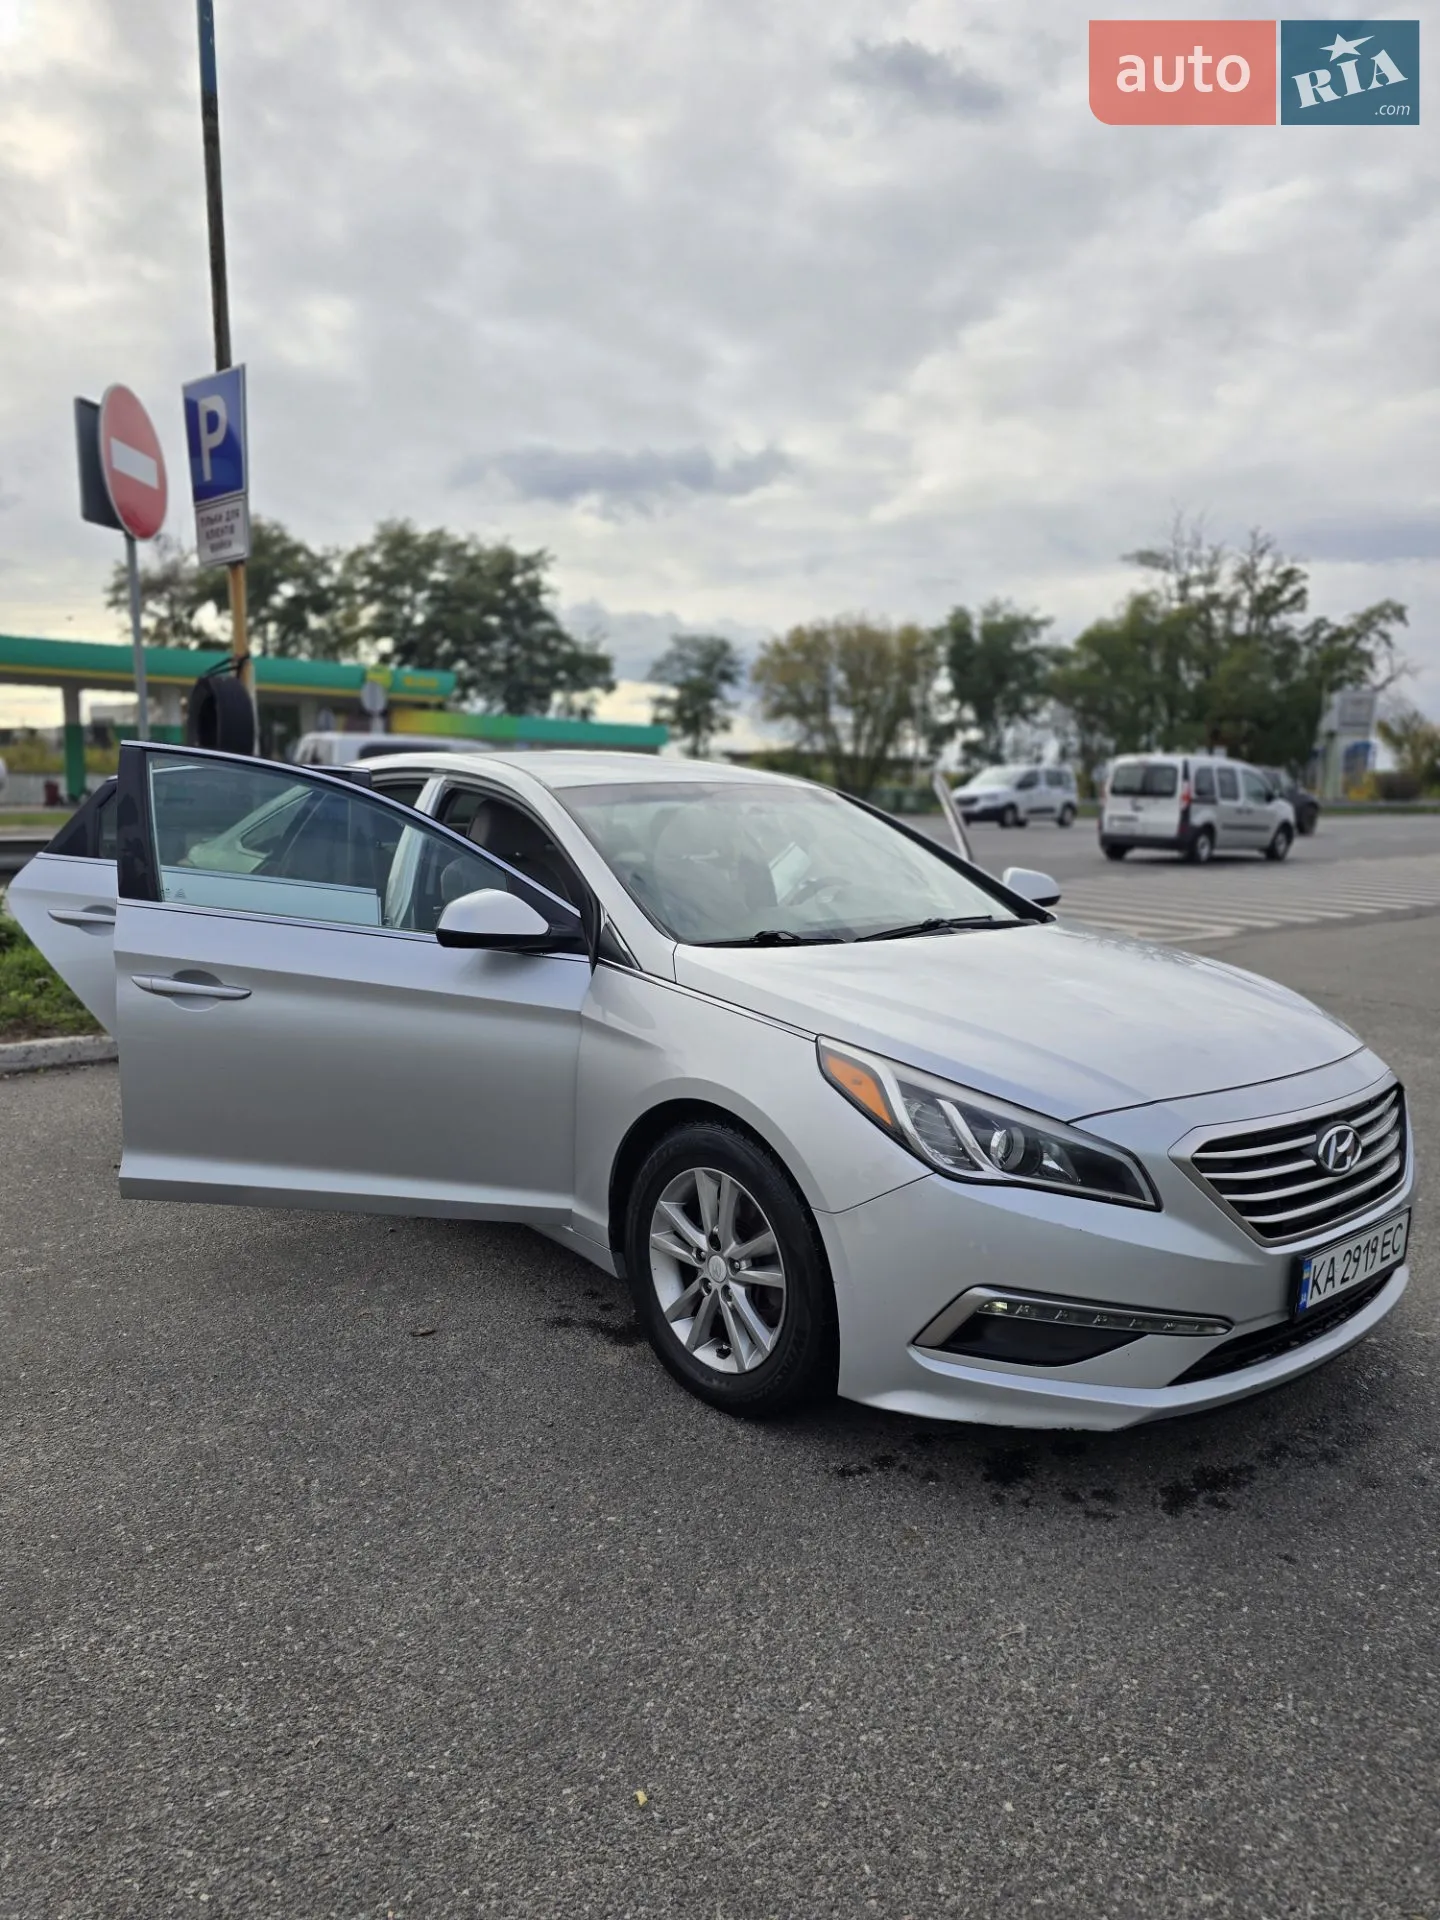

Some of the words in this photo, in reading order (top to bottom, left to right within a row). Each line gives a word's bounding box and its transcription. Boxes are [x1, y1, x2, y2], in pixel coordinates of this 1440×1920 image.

[198, 394, 228, 482] P
[225, 508, 240, 521] ДЛЯ
[1310, 1257, 1335, 1300] KA
[1340, 1235, 1379, 1285] 2919
[1380, 1223, 1404, 1263] EC
